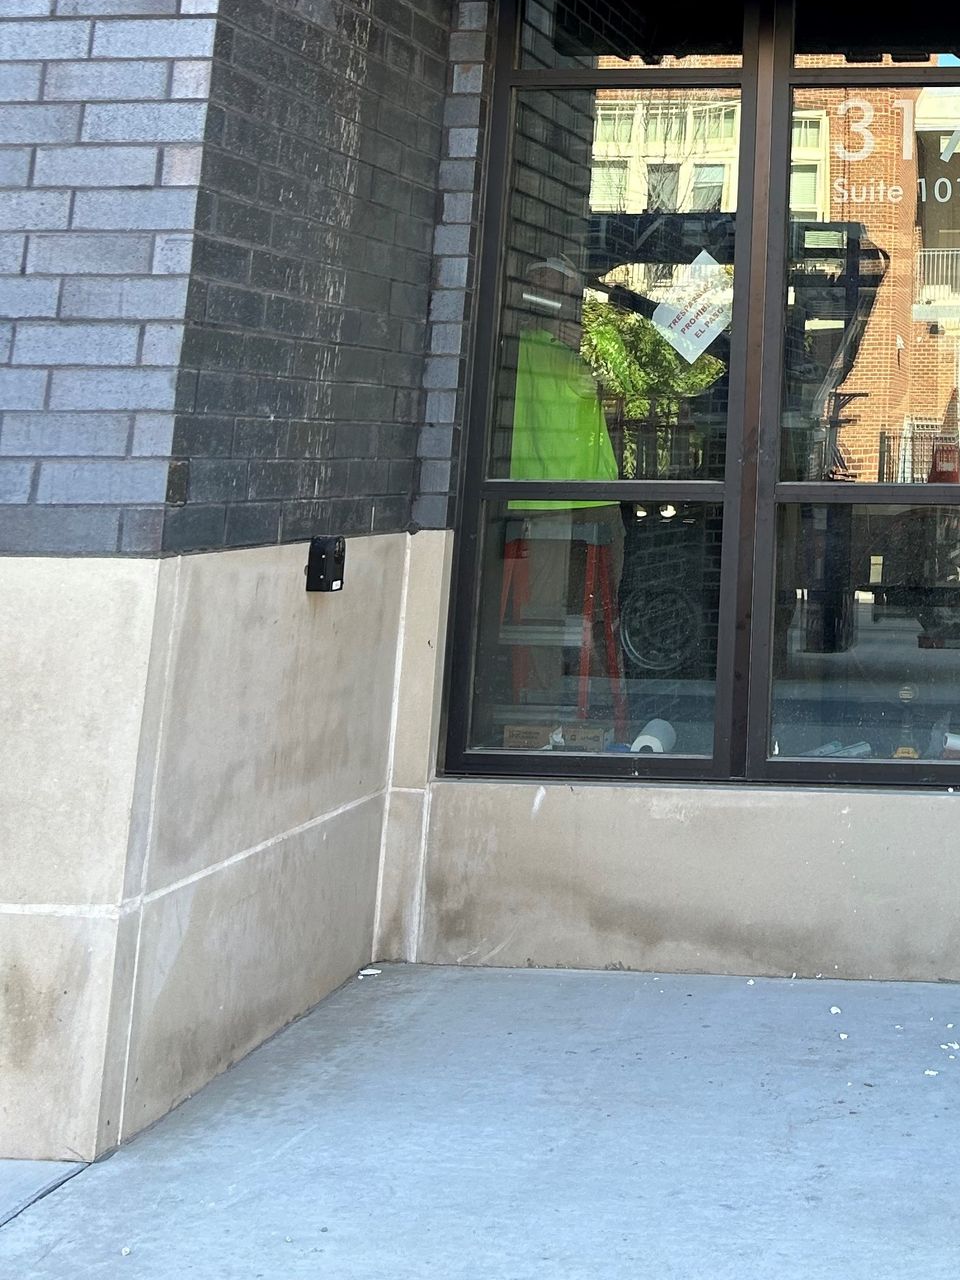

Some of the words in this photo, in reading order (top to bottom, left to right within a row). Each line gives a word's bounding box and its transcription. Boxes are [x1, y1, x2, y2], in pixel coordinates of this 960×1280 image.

[833, 177, 904, 203] Suite
[694, 326, 706, 338] EL
[704, 306, 725, 328] PASO
